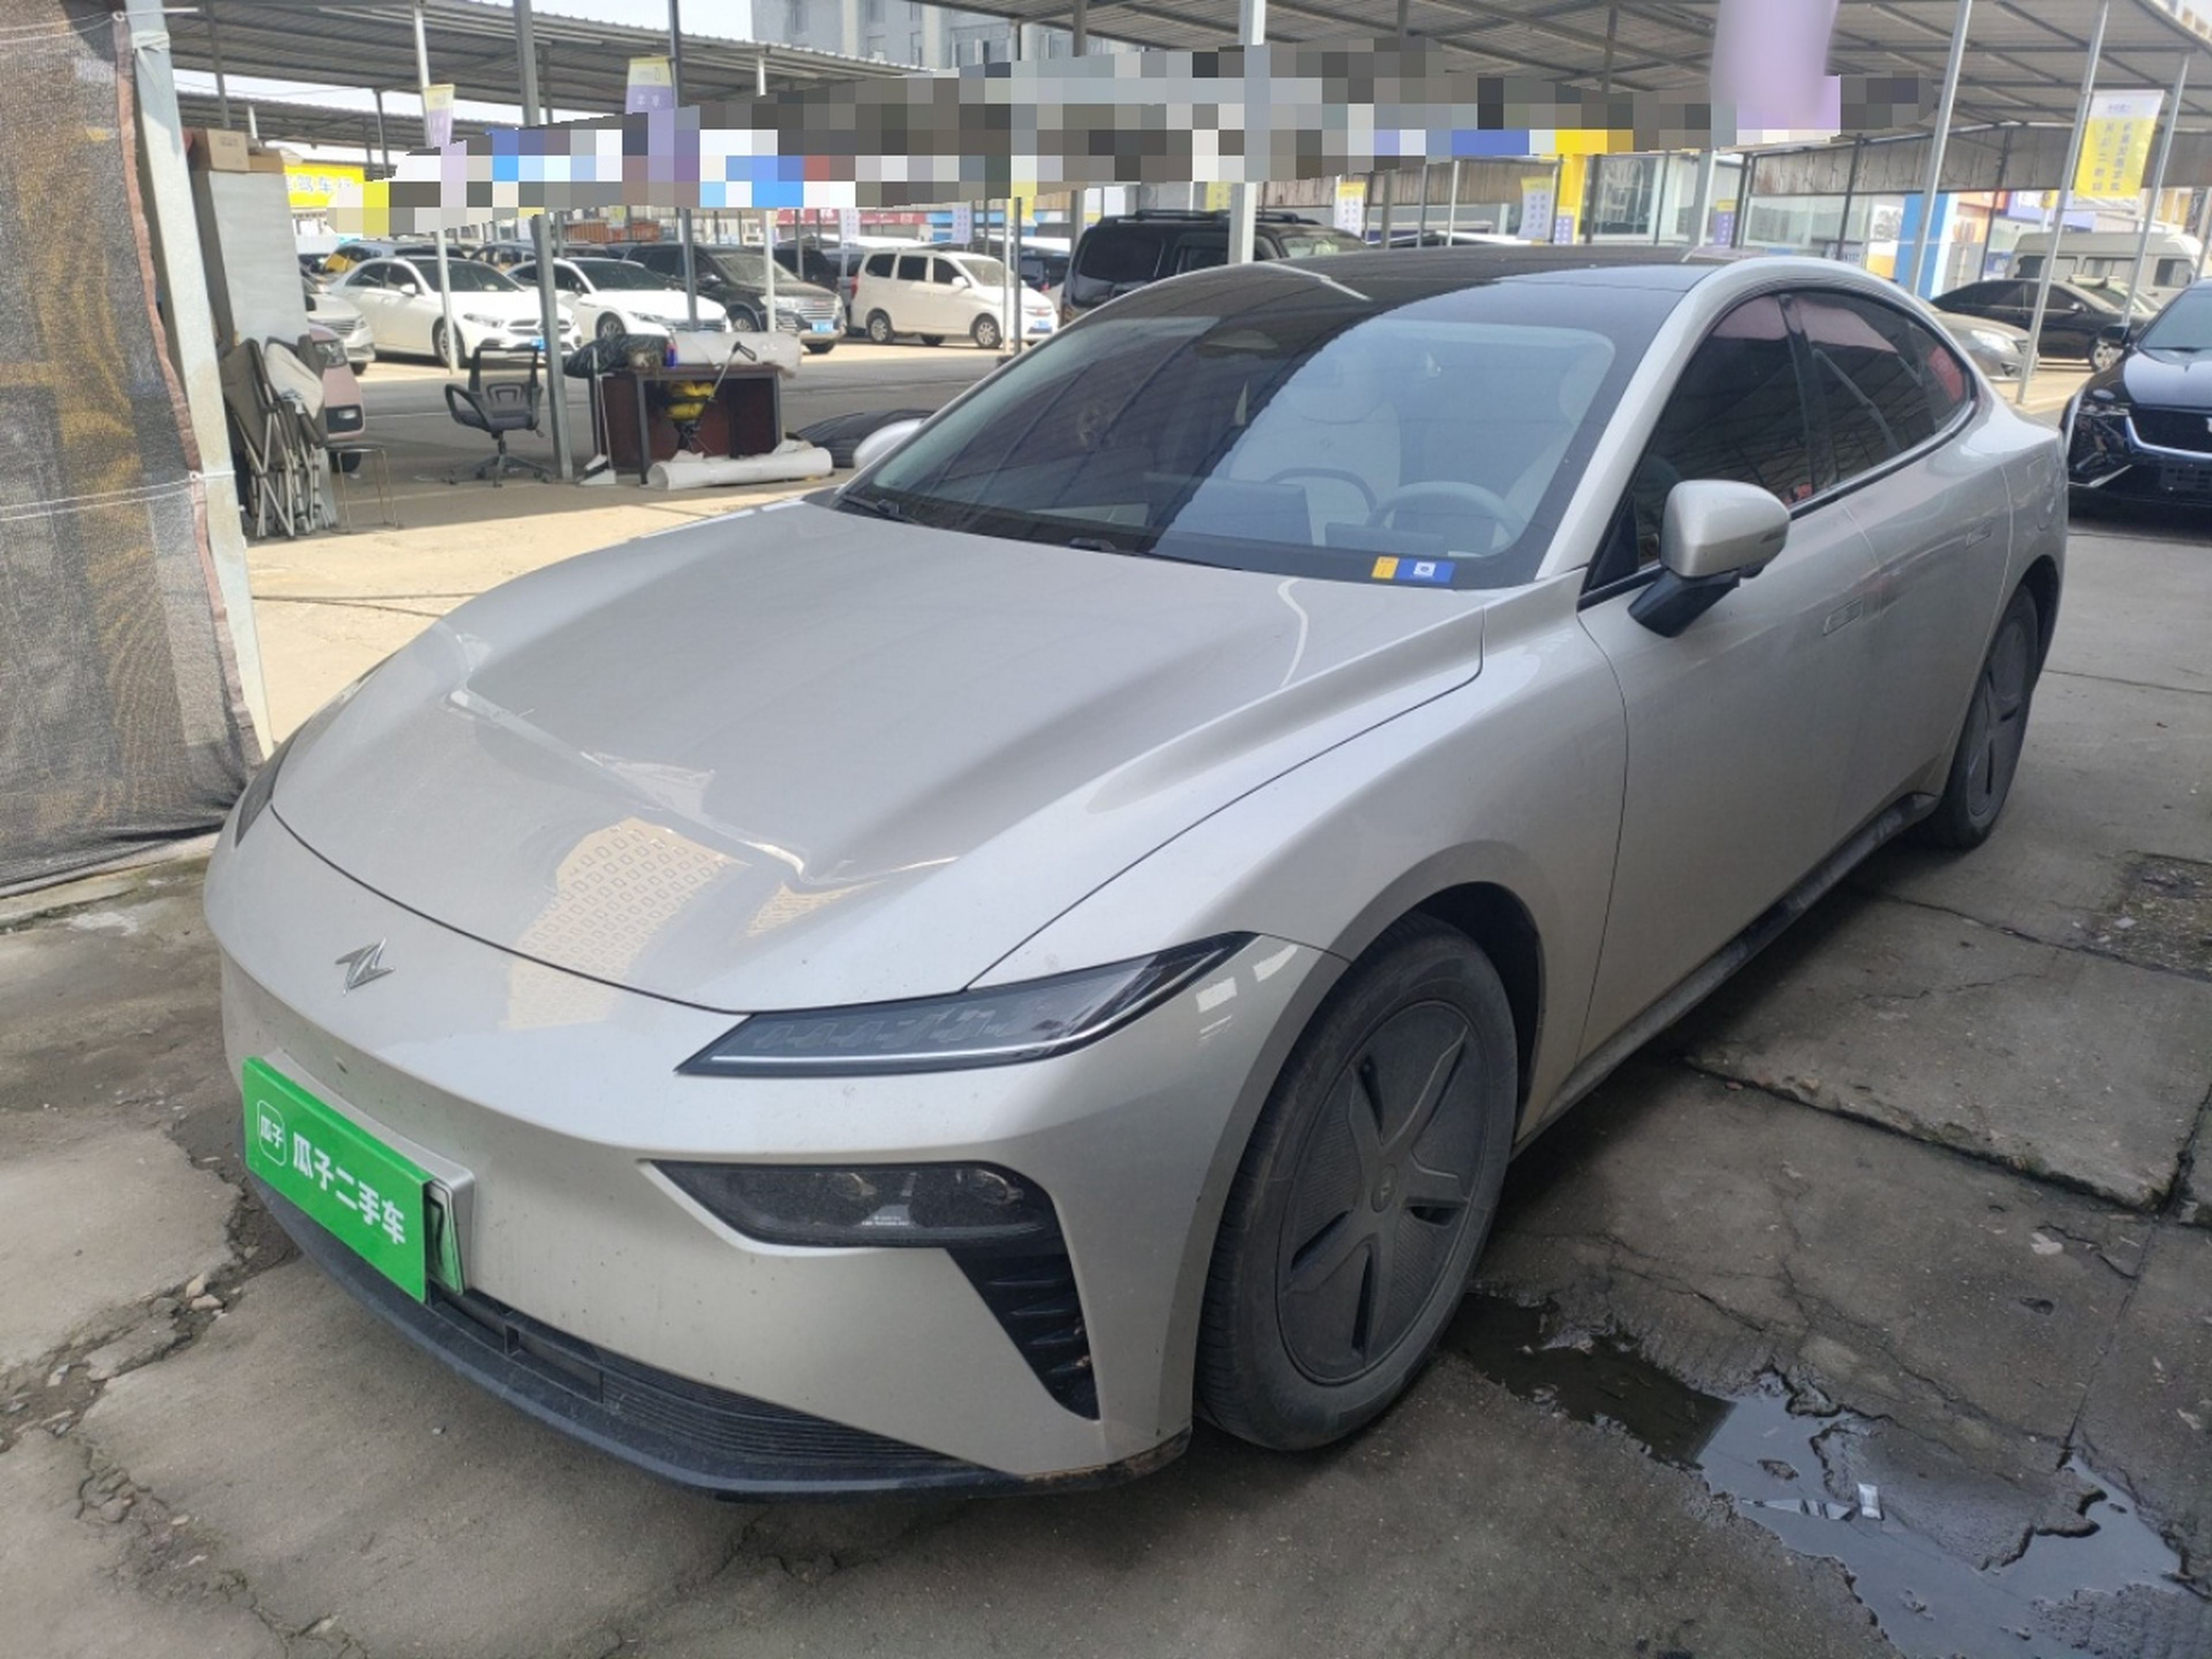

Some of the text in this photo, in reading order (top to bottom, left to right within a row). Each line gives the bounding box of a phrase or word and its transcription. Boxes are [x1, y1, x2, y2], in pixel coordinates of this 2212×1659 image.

[260, 1115, 283, 1149] 瓜子
[293, 1131, 406, 1244] 瓜子二手车
